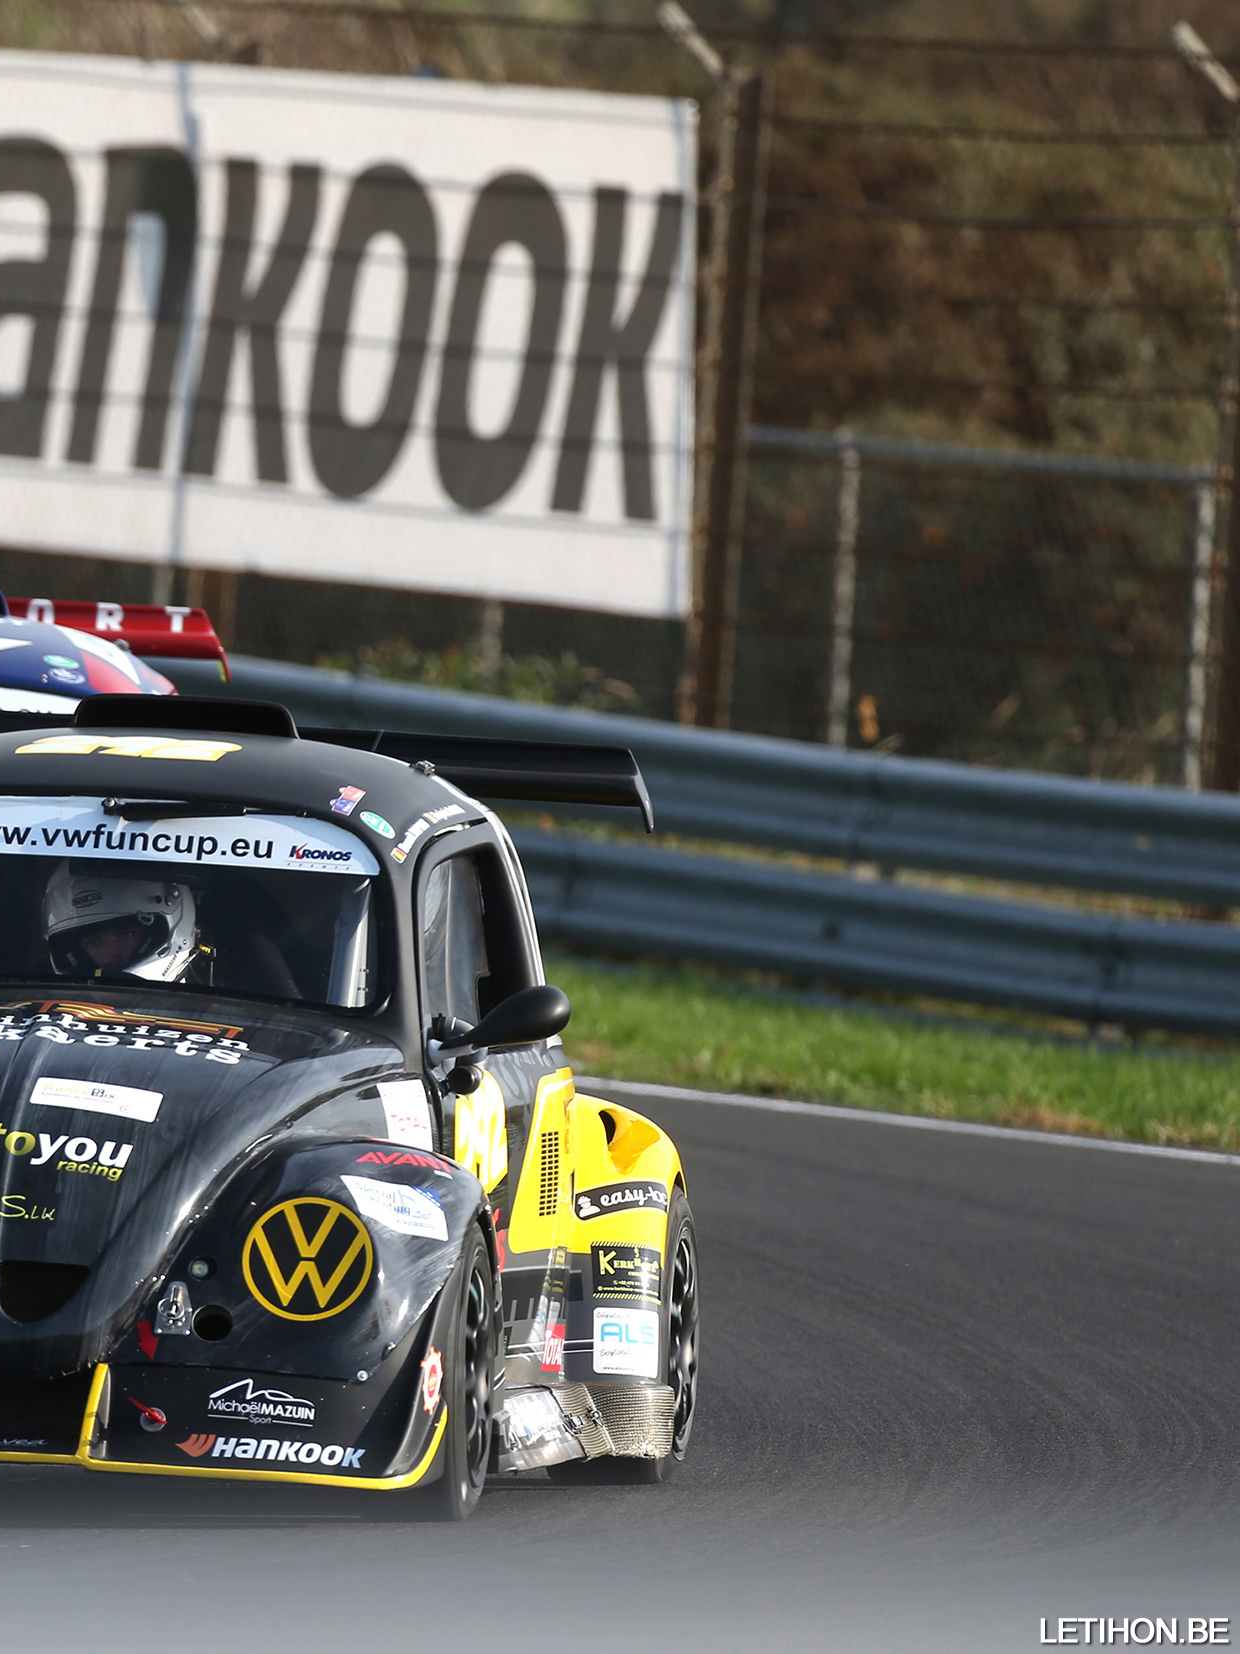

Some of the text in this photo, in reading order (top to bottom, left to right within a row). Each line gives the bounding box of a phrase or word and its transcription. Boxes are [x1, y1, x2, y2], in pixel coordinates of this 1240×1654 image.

[288, 842, 353, 862] KRONOS
[56, 1158, 124, 1182] racing
[355, 1151, 453, 1174] AVANT
[600, 1322, 656, 1346] ALS
[248, 1413, 272, 1425] Sport
